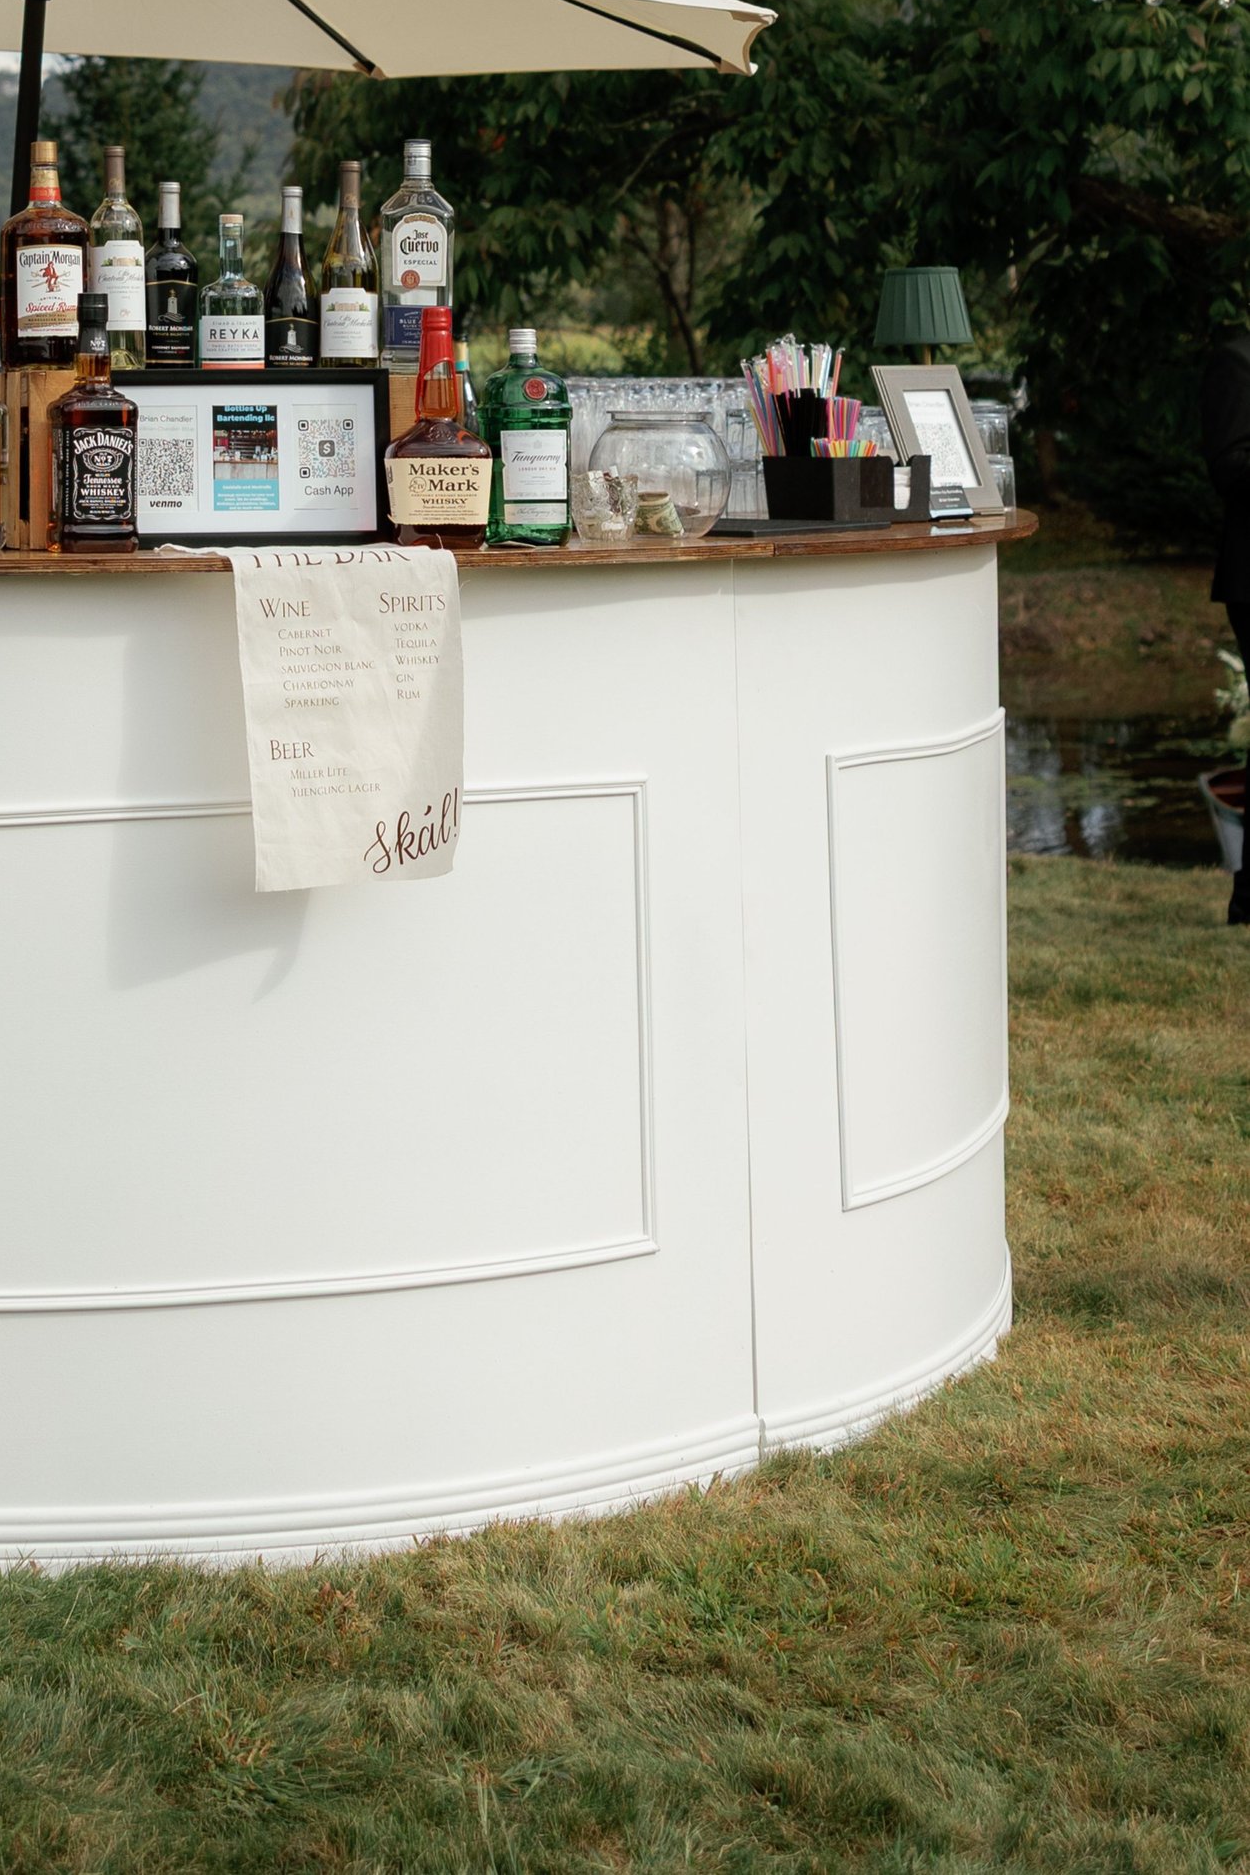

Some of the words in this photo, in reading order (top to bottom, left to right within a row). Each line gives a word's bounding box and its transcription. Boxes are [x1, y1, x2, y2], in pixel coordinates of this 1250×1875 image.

[400, 236, 439, 255] Cuervo
[19, 251, 52, 267] Captain
[52, 250, 80, 267] Morgan
[25, 302, 55, 314] Spiced
[210, 328, 259, 339] REYKA
[256, 405, 267, 413] Up
[140, 415, 159, 423] Brian
[160, 415, 193, 423] Chandler
[217, 414, 263, 423] Bartending
[265, 414, 275, 422] llc
[73, 435, 97, 455] JACK
[97, 431, 134, 455] DANIEL'S
[511, 451, 561, 464] Tanqueray
[409, 463, 479, 476] Maker's
[83, 473, 123, 484] Tennessee
[304, 485, 331, 495] Cash
[334, 485, 354, 497] App
[428, 479, 479, 492] Mark
[80, 488, 125, 496] WHISKEY
[150, 500, 182, 508] venmo
[259, 597, 311, 618] WINE
[379, 592, 446, 614] SPIRITS
[394, 622, 429, 632] VODKA
[278, 629, 333, 640] CABERNET
[395, 638, 438, 649] TEQUILA
[279, 646, 310, 657] PINOT
[314, 644, 343, 655] NOIR
[395, 655, 441, 665] WHISKEY
[396, 673, 415, 683] GIN
[397, 689, 421, 700] RUM
[270, 739, 315, 761] BEER
